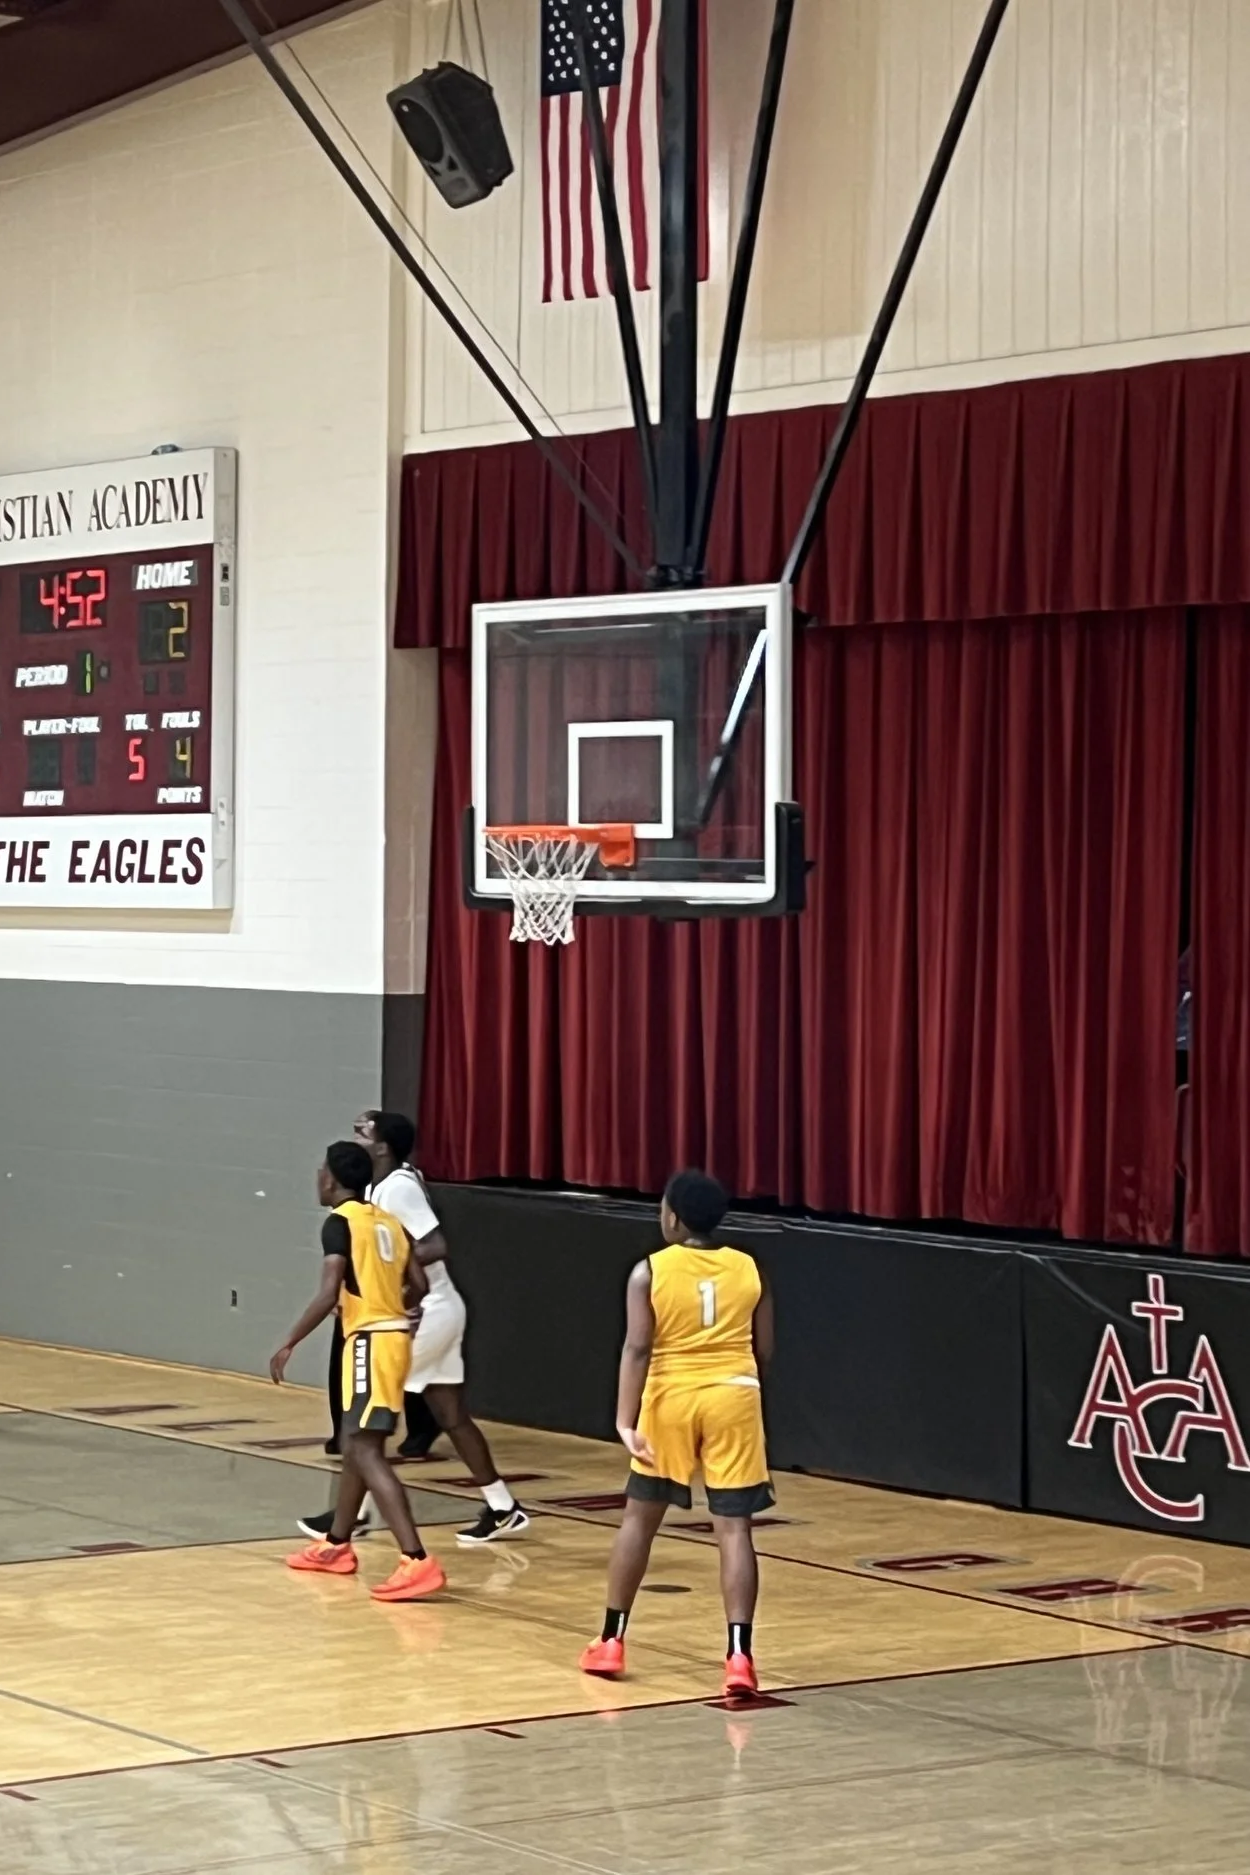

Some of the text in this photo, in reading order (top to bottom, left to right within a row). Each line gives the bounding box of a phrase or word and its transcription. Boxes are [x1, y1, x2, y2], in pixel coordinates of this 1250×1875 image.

[87, 472, 209, 532] ACADEMY
[135, 560, 194, 590] HOME
[39, 569, 107, 629] 4:52
[168, 601, 189, 658] 2
[15, 664, 69, 688] PERIOD
[128, 737, 146, 781] 5
[175, 736, 192, 779] 4
[67, 837, 207, 886] EAGLES
[698, 1280, 716, 1327] 1
